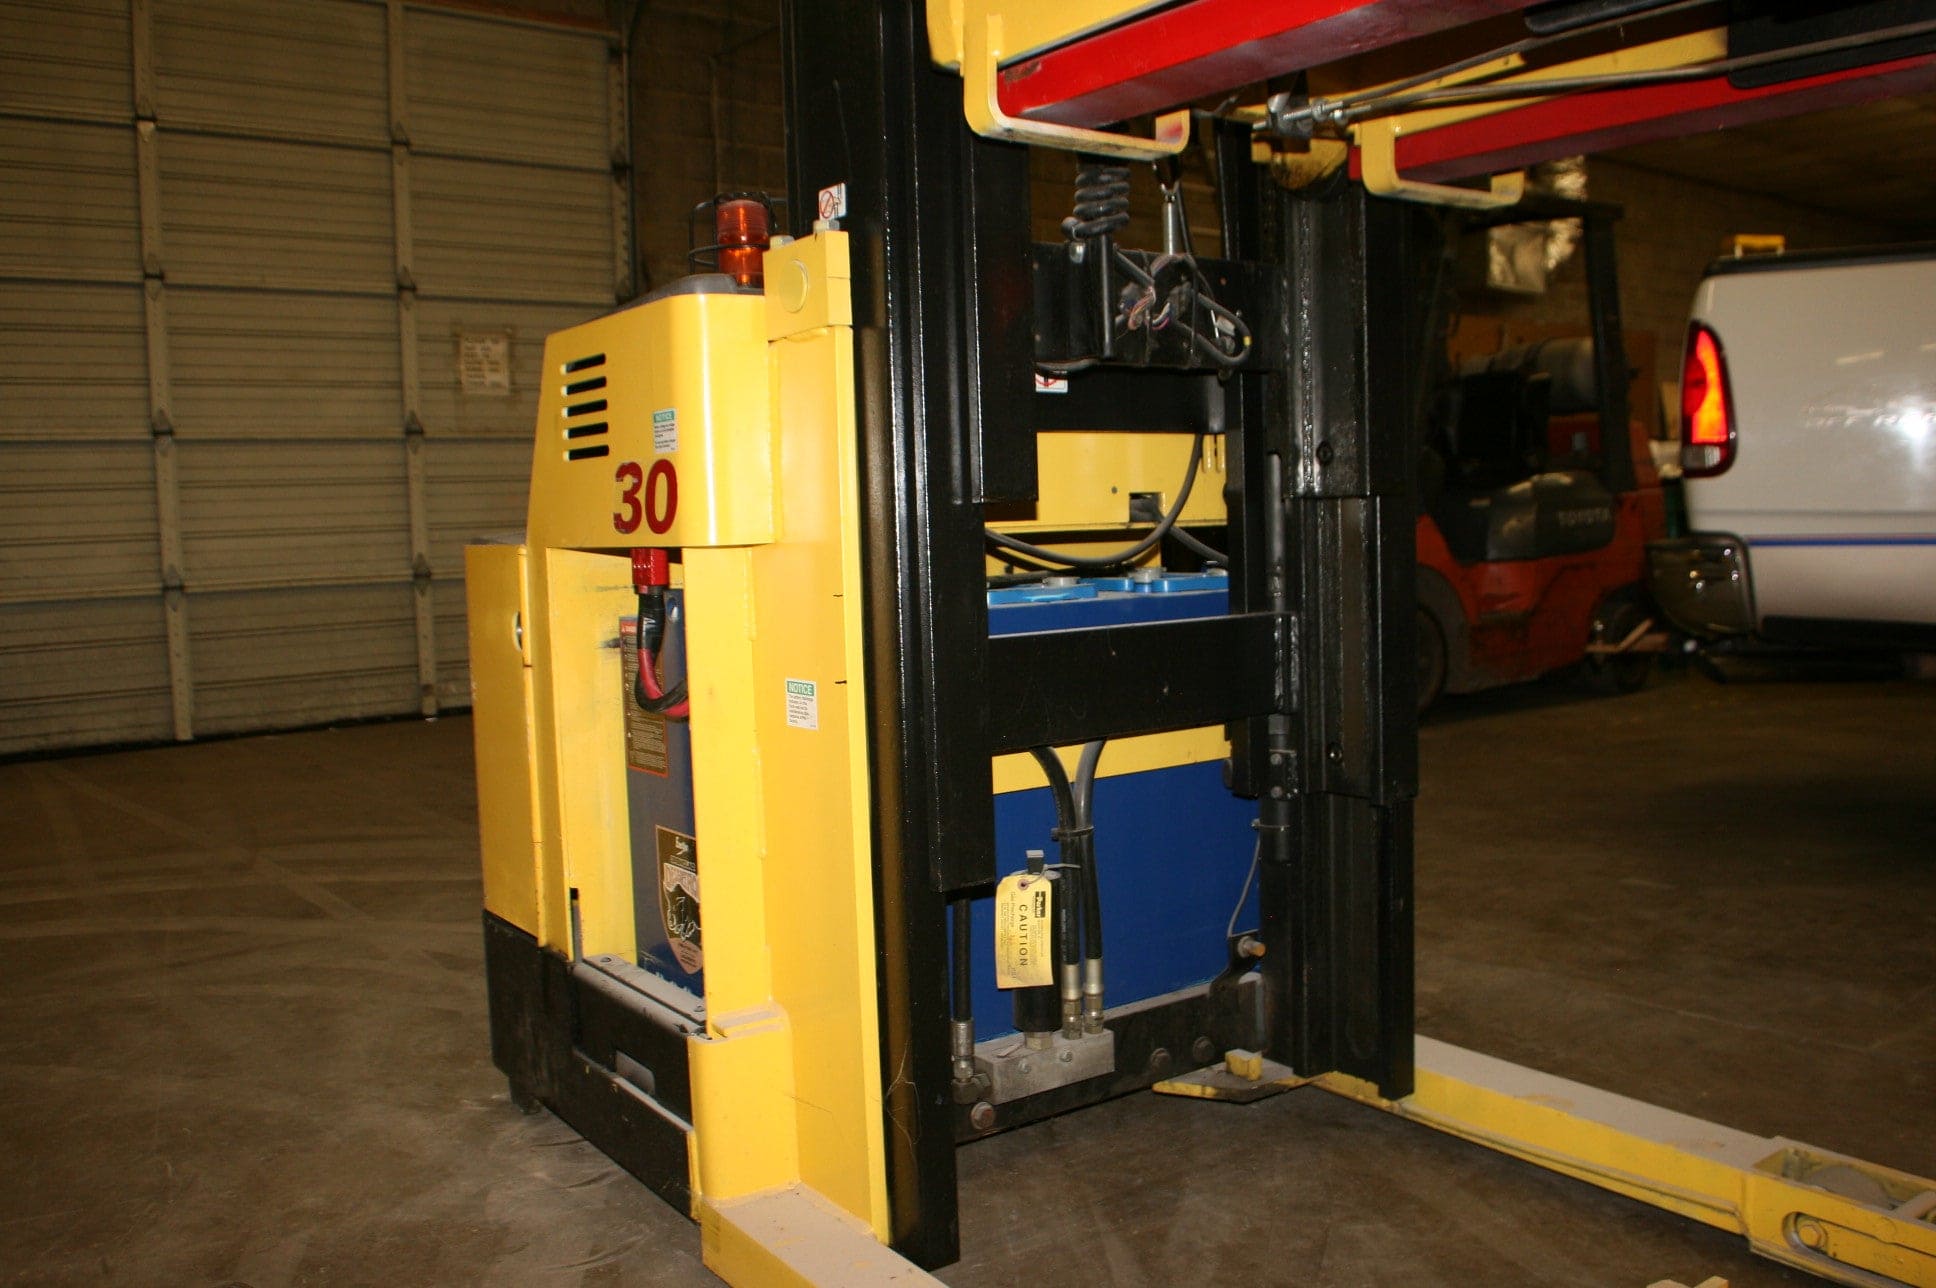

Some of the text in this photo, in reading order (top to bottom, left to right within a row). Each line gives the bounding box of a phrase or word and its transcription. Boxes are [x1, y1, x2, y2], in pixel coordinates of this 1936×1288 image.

[614, 458, 678, 535] 30
[1558, 508, 1610, 526] TOYOTA
[788, 682, 813, 695] NOTICE
[1019, 904, 1028, 966] CAUTION
